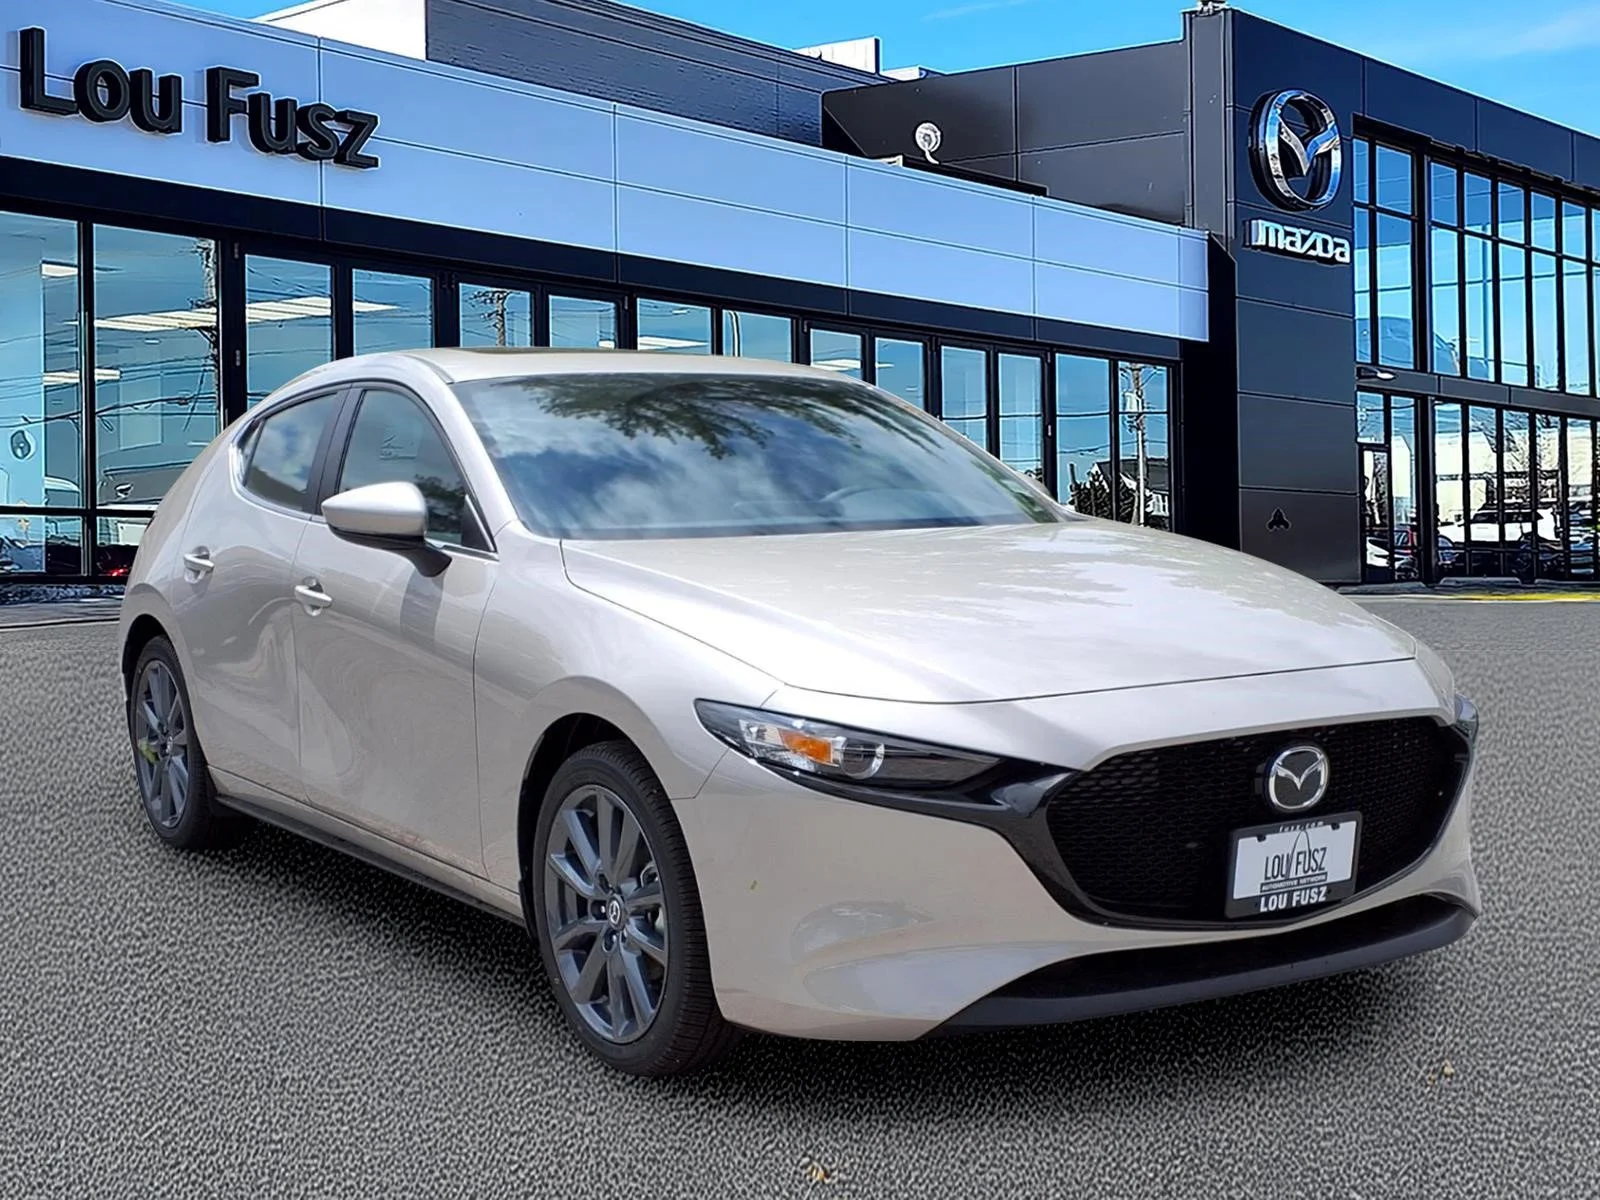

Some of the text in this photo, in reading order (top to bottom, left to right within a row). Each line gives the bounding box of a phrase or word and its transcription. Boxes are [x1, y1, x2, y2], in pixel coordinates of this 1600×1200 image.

[19, 27, 379, 169] Lou Fusz
[1249, 218, 1350, 264] mazda
[1264, 847, 1327, 880] LOU FUSZ
[1260, 886, 1328, 912] LOU FUSZ
